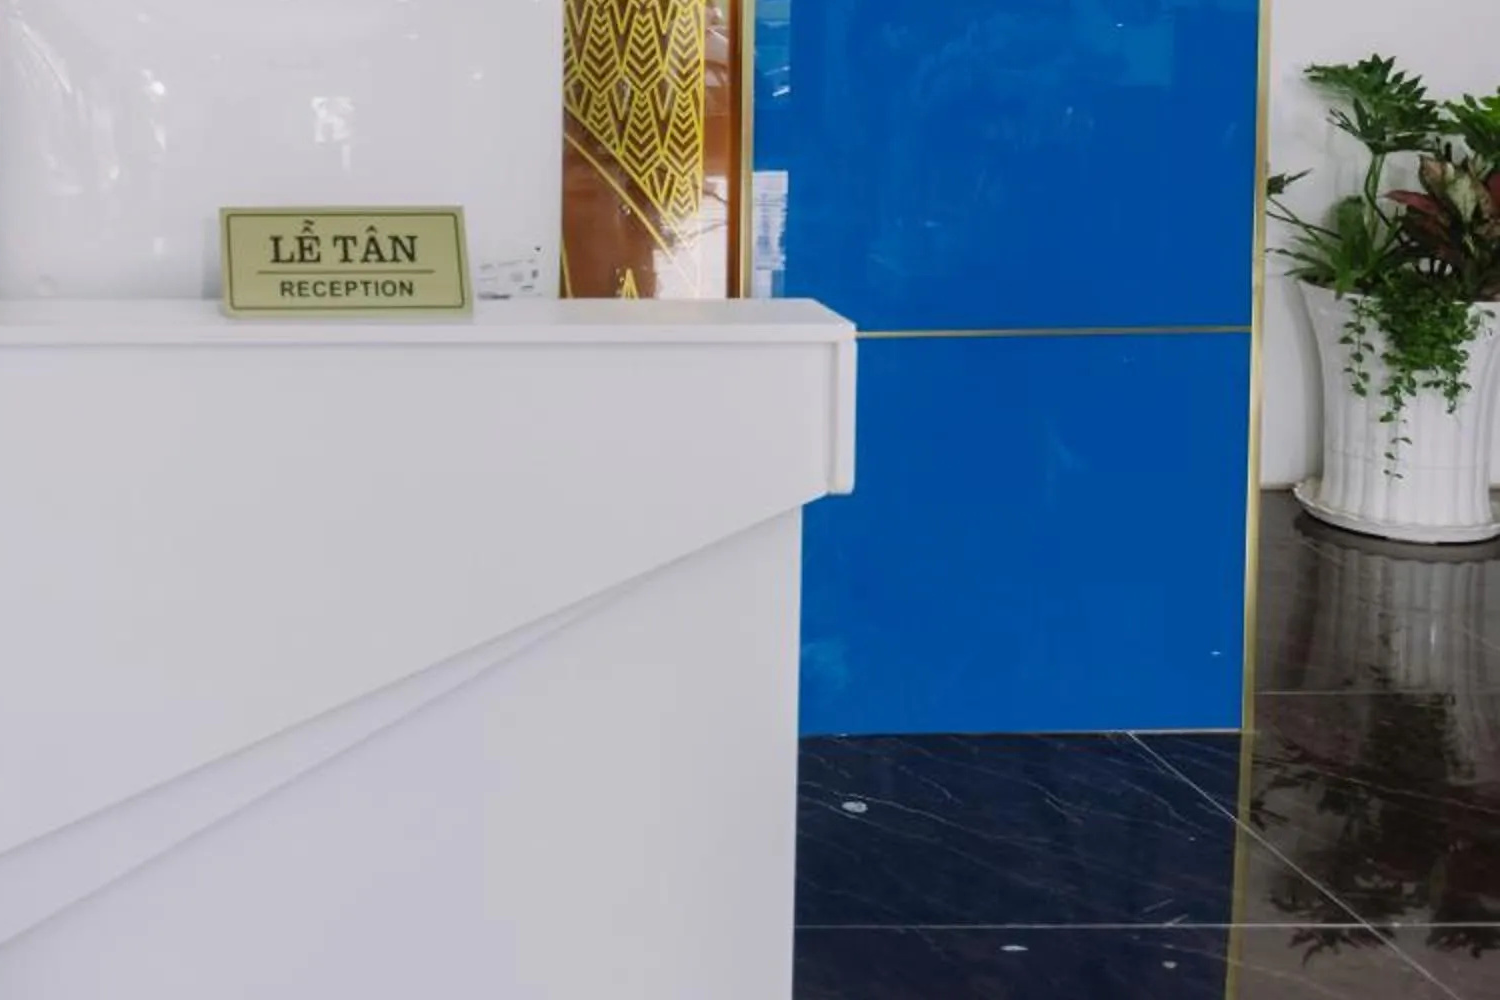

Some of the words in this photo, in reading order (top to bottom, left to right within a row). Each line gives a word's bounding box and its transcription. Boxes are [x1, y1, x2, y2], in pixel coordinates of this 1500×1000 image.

[269, 218, 321, 264] LỄ
[332, 224, 419, 264] TÂN
[279, 279, 414, 298] RECEPTION
